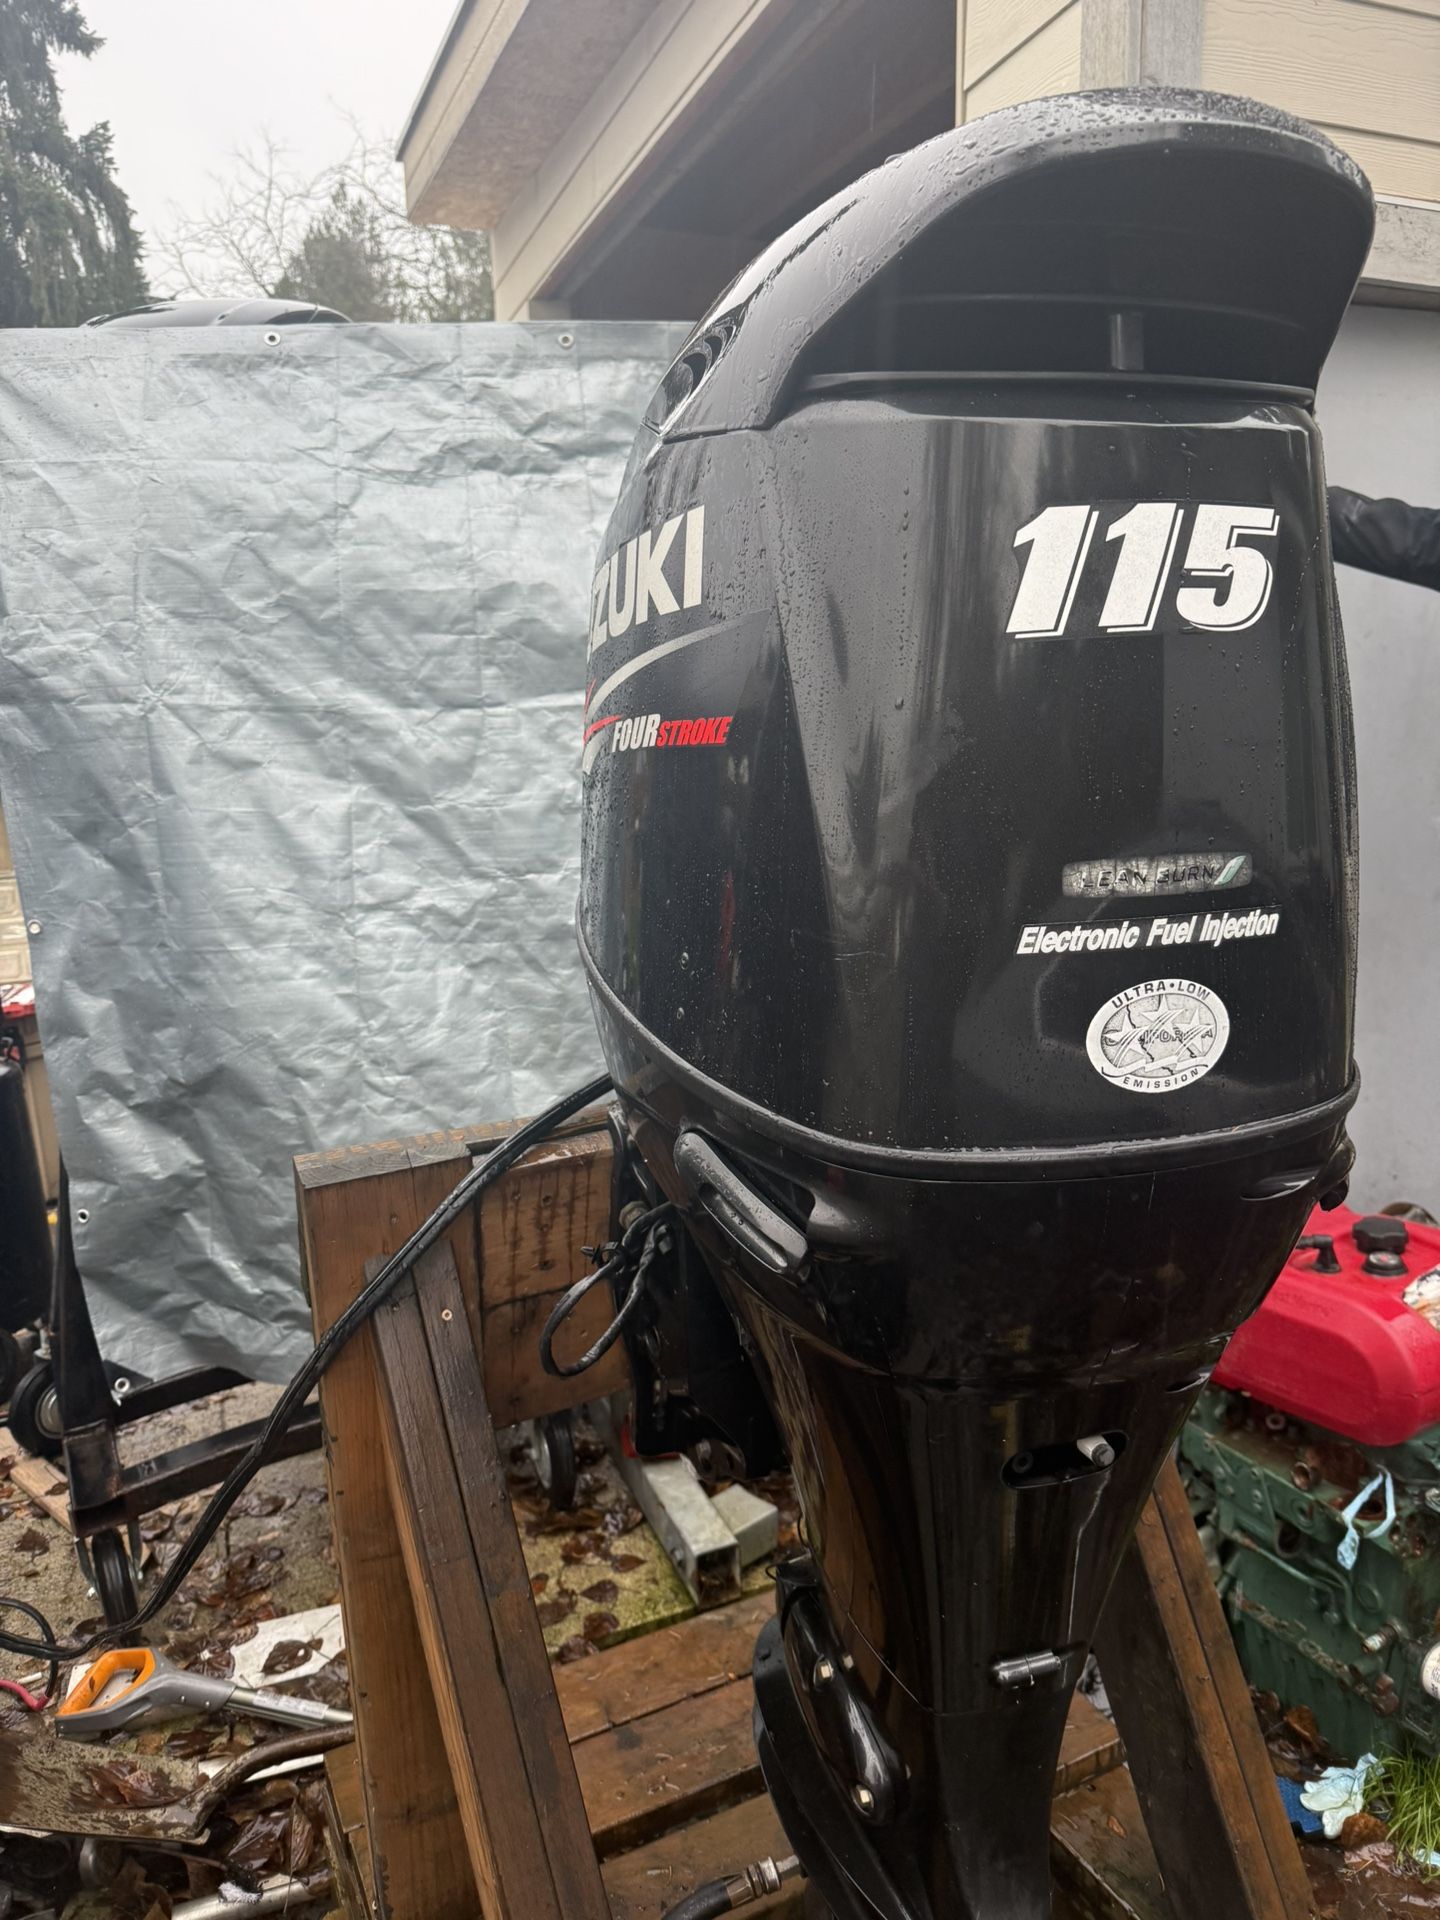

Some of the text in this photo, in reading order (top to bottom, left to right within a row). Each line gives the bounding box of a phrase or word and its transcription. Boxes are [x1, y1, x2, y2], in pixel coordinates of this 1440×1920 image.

[587, 505, 705, 664] ZUKI
[1006, 502, 1280, 639] 115
[1080, 865, 1214, 888] LEAN BURN
[1017, 909, 1280, 955] Electronic Fuel Injection
[1123, 1068, 1199, 1089] EMISSION
